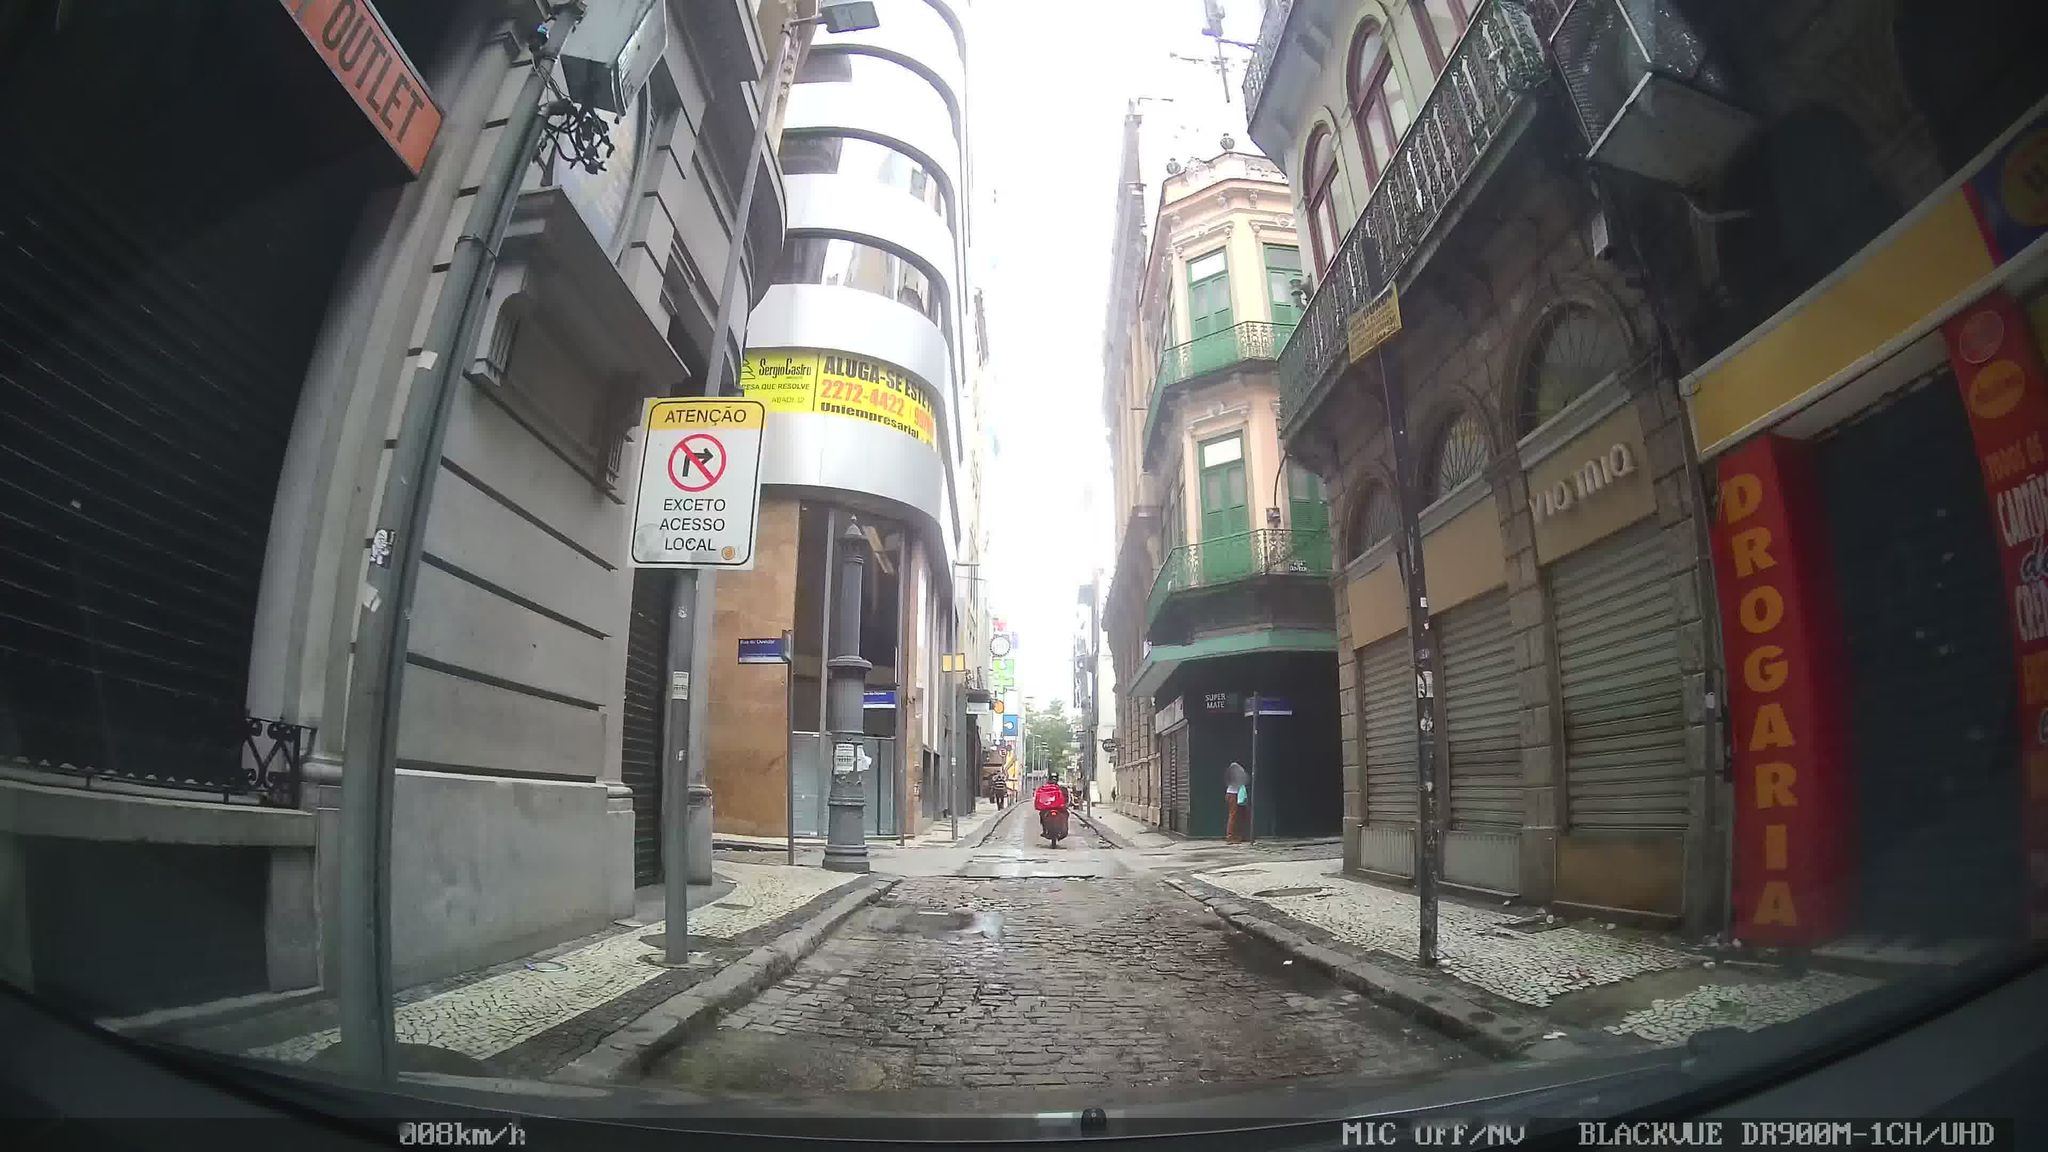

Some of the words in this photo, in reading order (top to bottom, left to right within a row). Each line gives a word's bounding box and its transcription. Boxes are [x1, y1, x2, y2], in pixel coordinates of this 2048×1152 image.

[322, 0, 424, 143] OUTLET
[823, 355, 902, 393] ALUGA-SE
[820, 379, 904, 417] 2272-4422
[665, 406, 747, 426] ATENÇÃO
[820, 402, 919, 439] Uniempresarial
[664, 498, 726, 511] EXCETO
[659, 518, 725, 531] ACESSO
[664, 538, 716, 551] LOCAL
[1205, 693, 1226, 702] SUPER
[1724, 473, 1799, 927] DROGARIA
